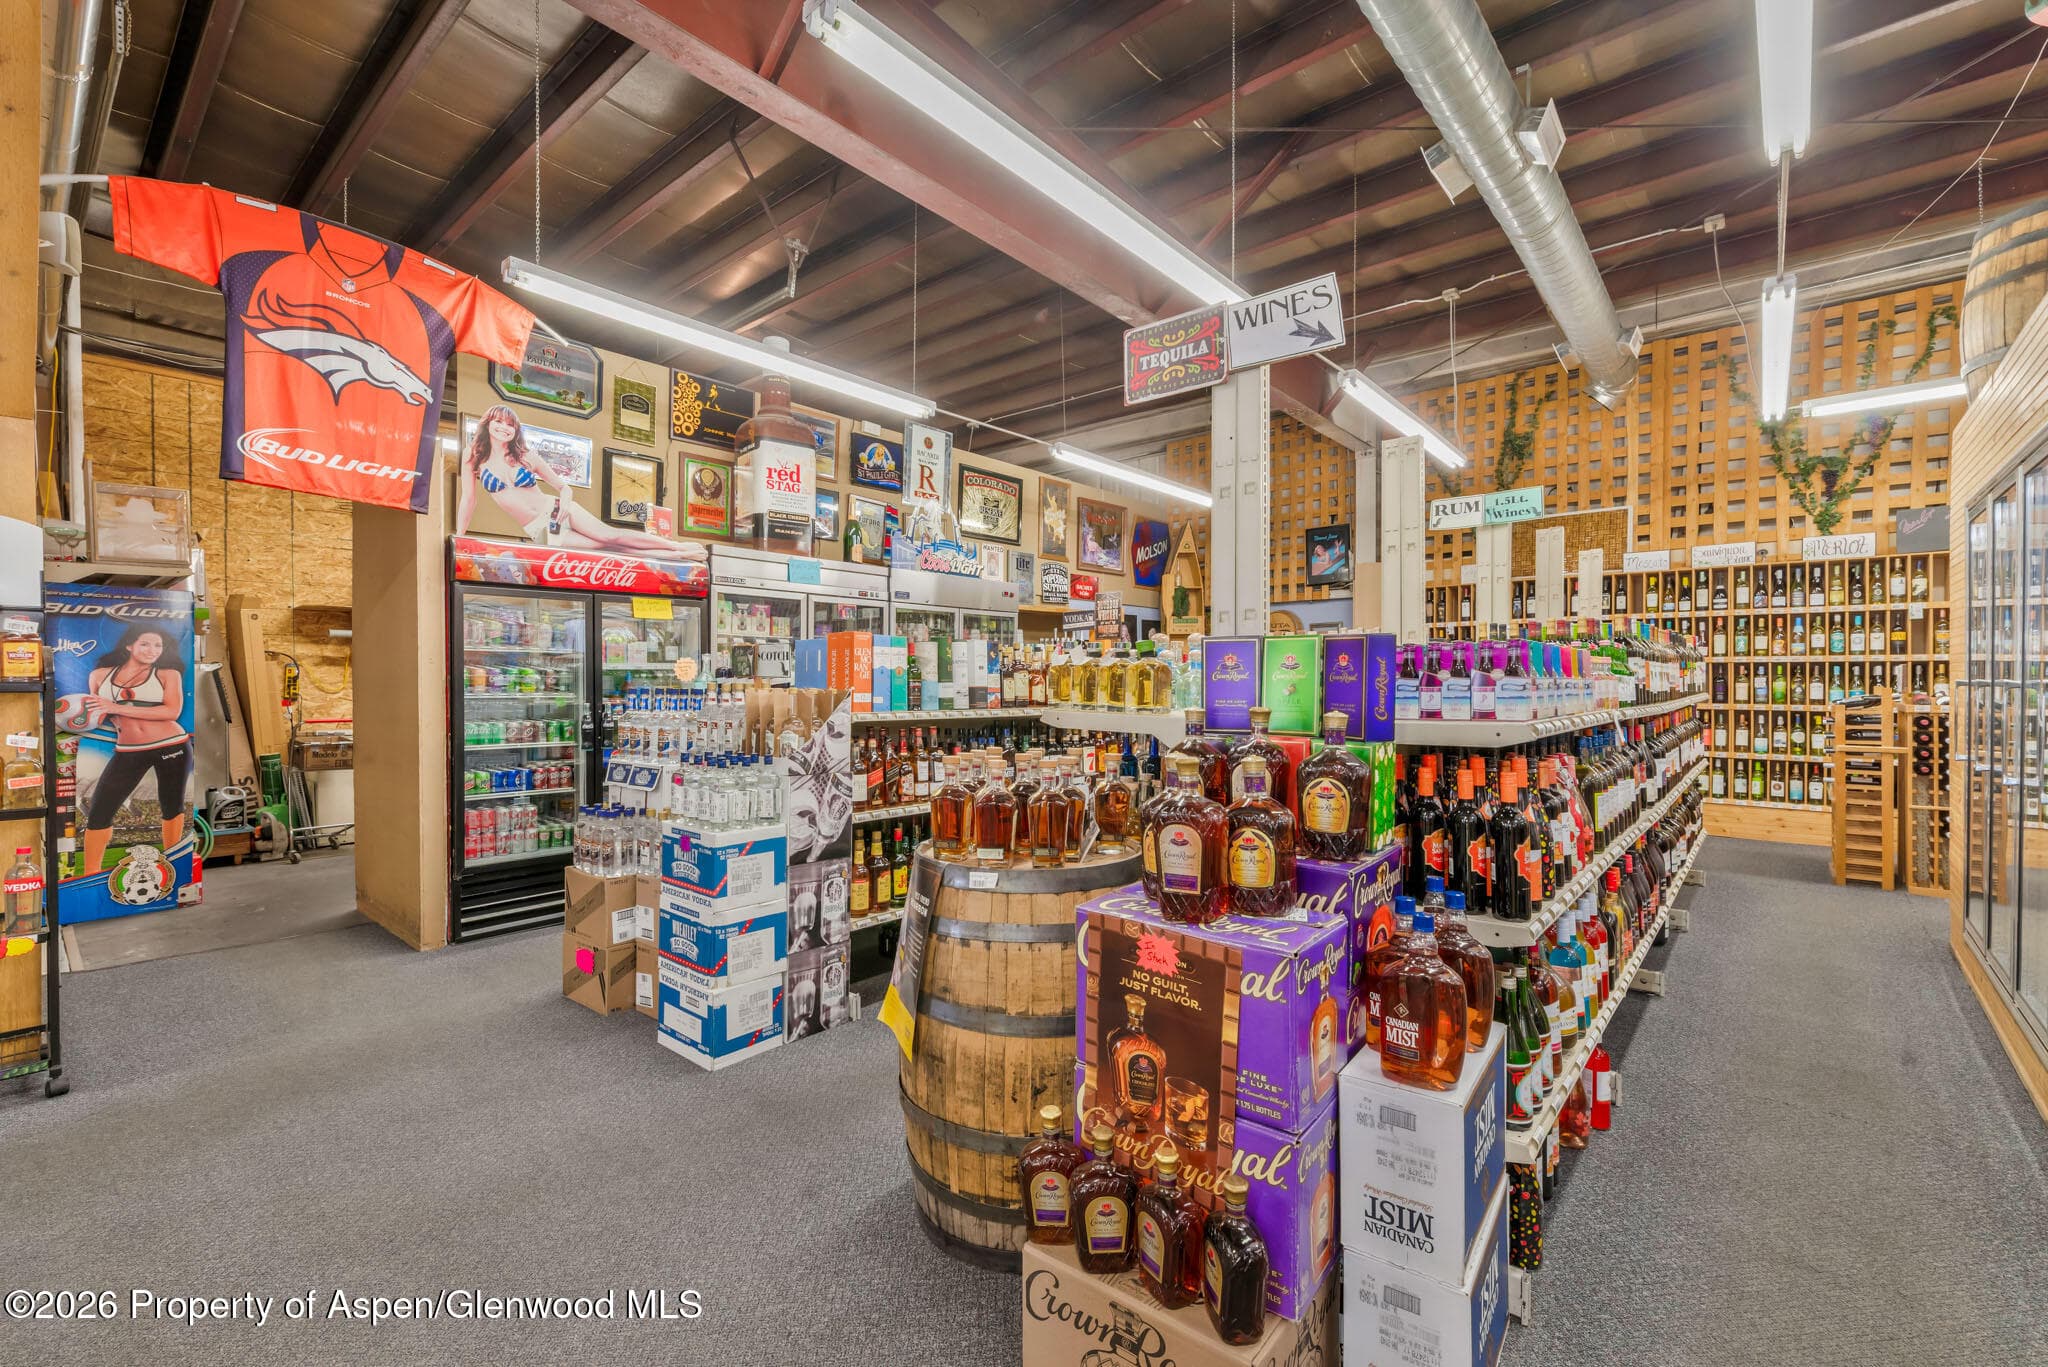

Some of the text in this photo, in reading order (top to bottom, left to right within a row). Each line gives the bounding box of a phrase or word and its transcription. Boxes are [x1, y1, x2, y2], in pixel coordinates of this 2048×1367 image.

[325, 290, 371, 308] BRONCOS
[1233, 284, 1333, 330] WINES
[527, 354, 571, 372] PAULANER
[1139, 340, 1209, 371] TEQUILA
[255, 437, 423, 483] BUD LIGHT
[766, 464, 801, 484] red
[766, 480, 801, 493] STAG
[968, 476, 1016, 495] COLORADO
[616, 500, 647, 517] Coor
[1434, 500, 1481, 517] RUM
[1492, 507, 1531, 519] Wines
[983, 544, 1004, 553] WANTED
[1136, 539, 1168, 564] MOLSON
[542, 551, 636, 588] Coca-Cola
[951, 557, 984, 577] LIGHT
[1043, 584, 1068, 592] SUTTON
[120, 607, 192, 619] LIGHT
[1064, 613, 1090, 624] VODKA
[854, 648, 871, 656] GLEN
[1212, 671, 1249, 682] Crown Royal
[4, 881, 41, 892] SVEDKA
[662, 885, 713, 908] AMERICAN VODKA
[672, 919, 697, 943] WHEATLEY
[660, 960, 711, 987] AMERICAN VODKA
[1296, 958, 1326, 995] Crown
[1324, 936, 1346, 975] Royal
[1133, 970, 1189, 997] NO GUILT,
[1119, 977, 1203, 1011] JUST FLAVOR.
[1385, 1016, 1419, 1032] CANADIAN
[1385, 1025, 1419, 1048] MIST
[1242, 1069, 1267, 1082] FINE
[1256, 1105, 1281, 1119] BOTTLES
[1365, 1195, 1435, 1240] MIST
[1364, 1220, 1435, 1254] CANADIAN
[1025, 1270, 1116, 1343] Crown
